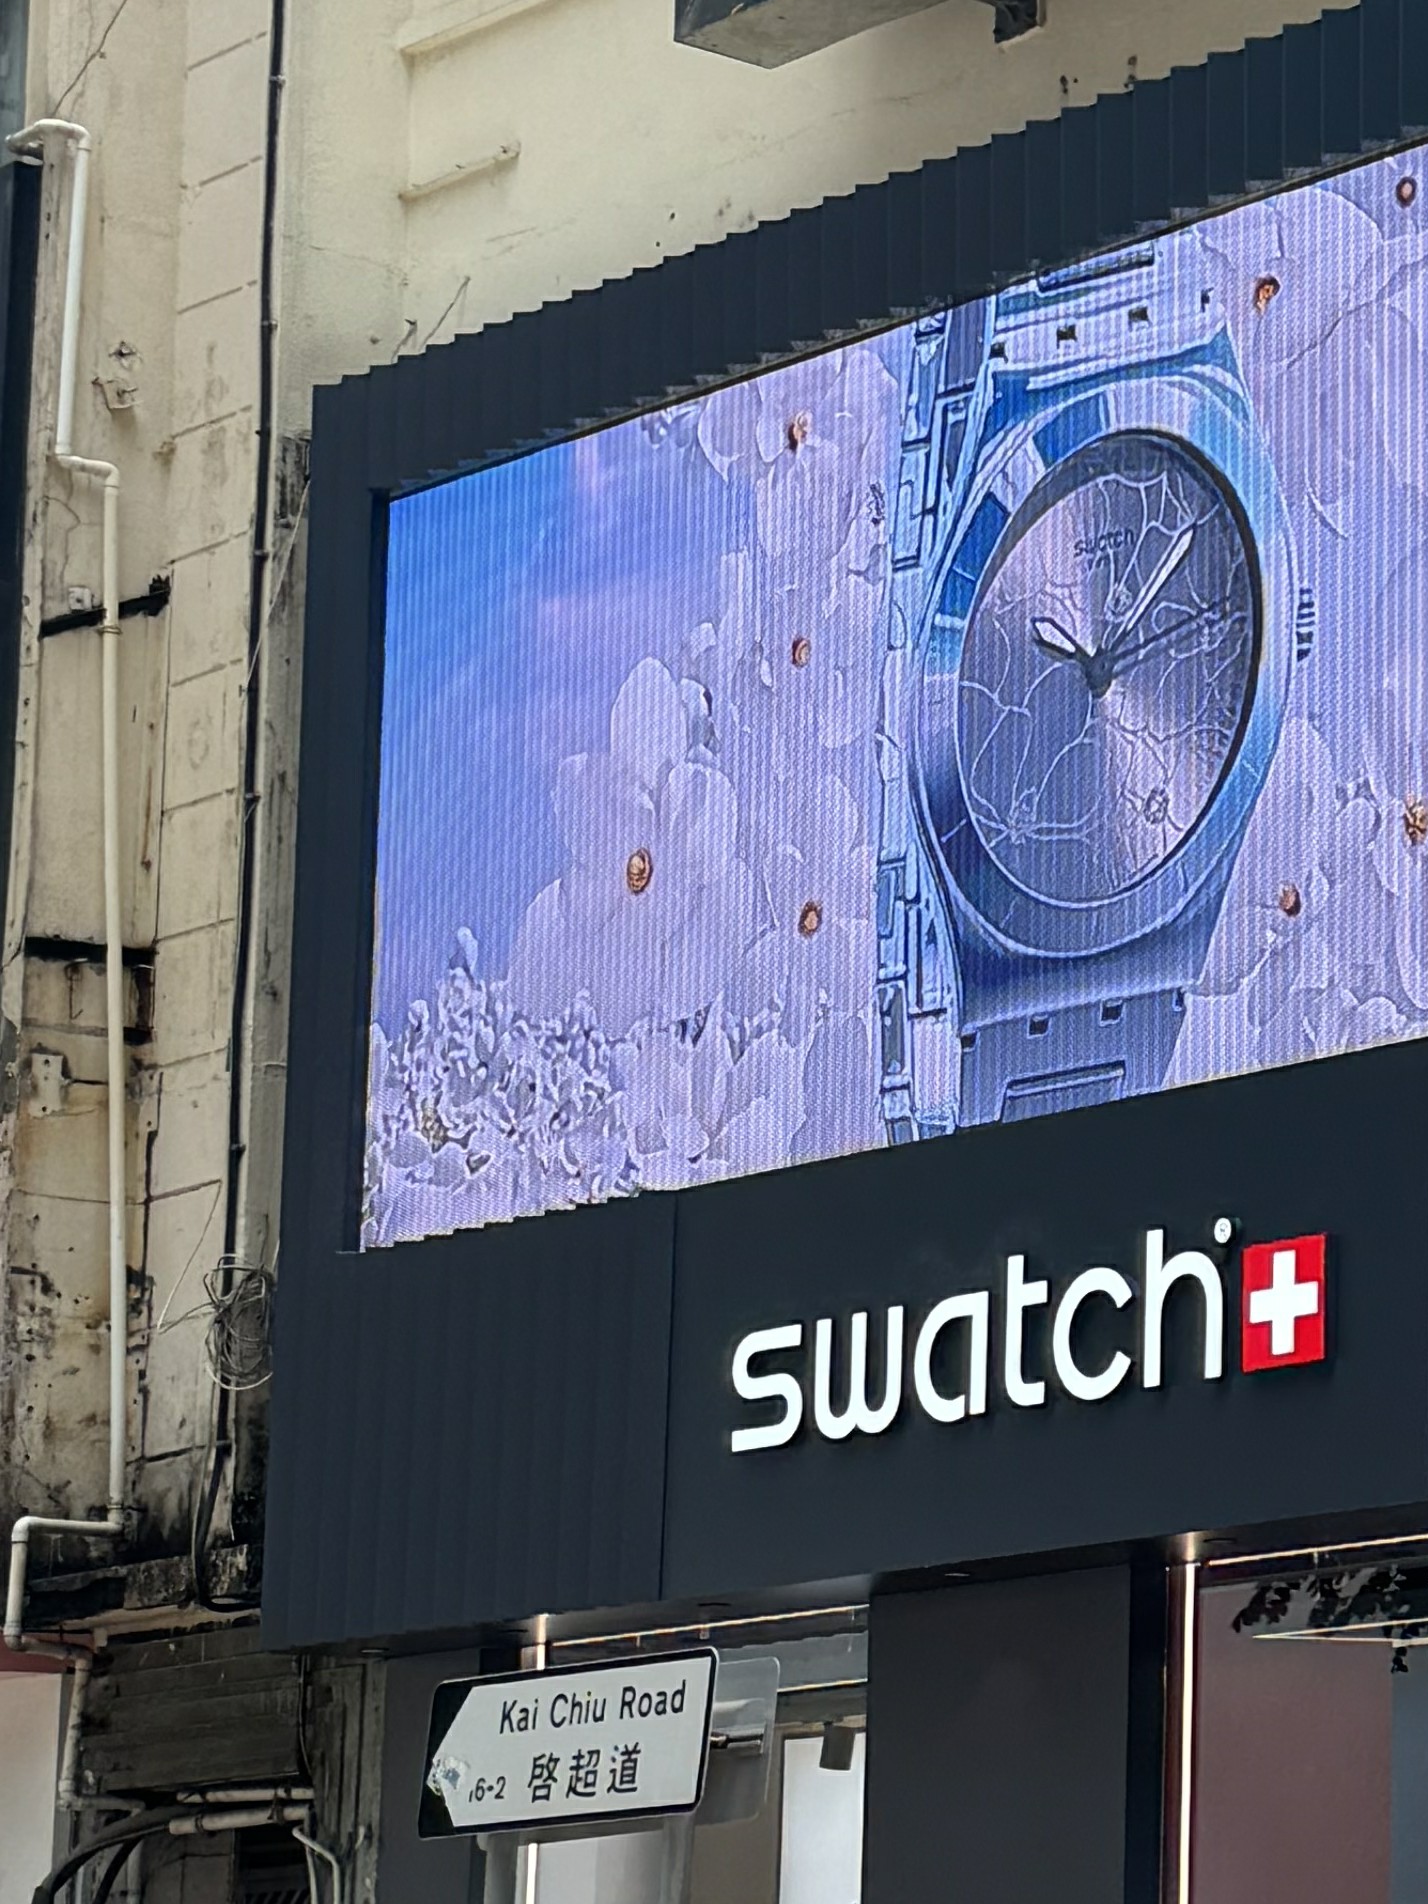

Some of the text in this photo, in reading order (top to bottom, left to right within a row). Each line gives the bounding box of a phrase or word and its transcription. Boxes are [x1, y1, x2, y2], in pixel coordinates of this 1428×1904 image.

[732, 1229, 1223, 1452] swatch
[499, 1679, 686, 1735] Kai Chiu Road
